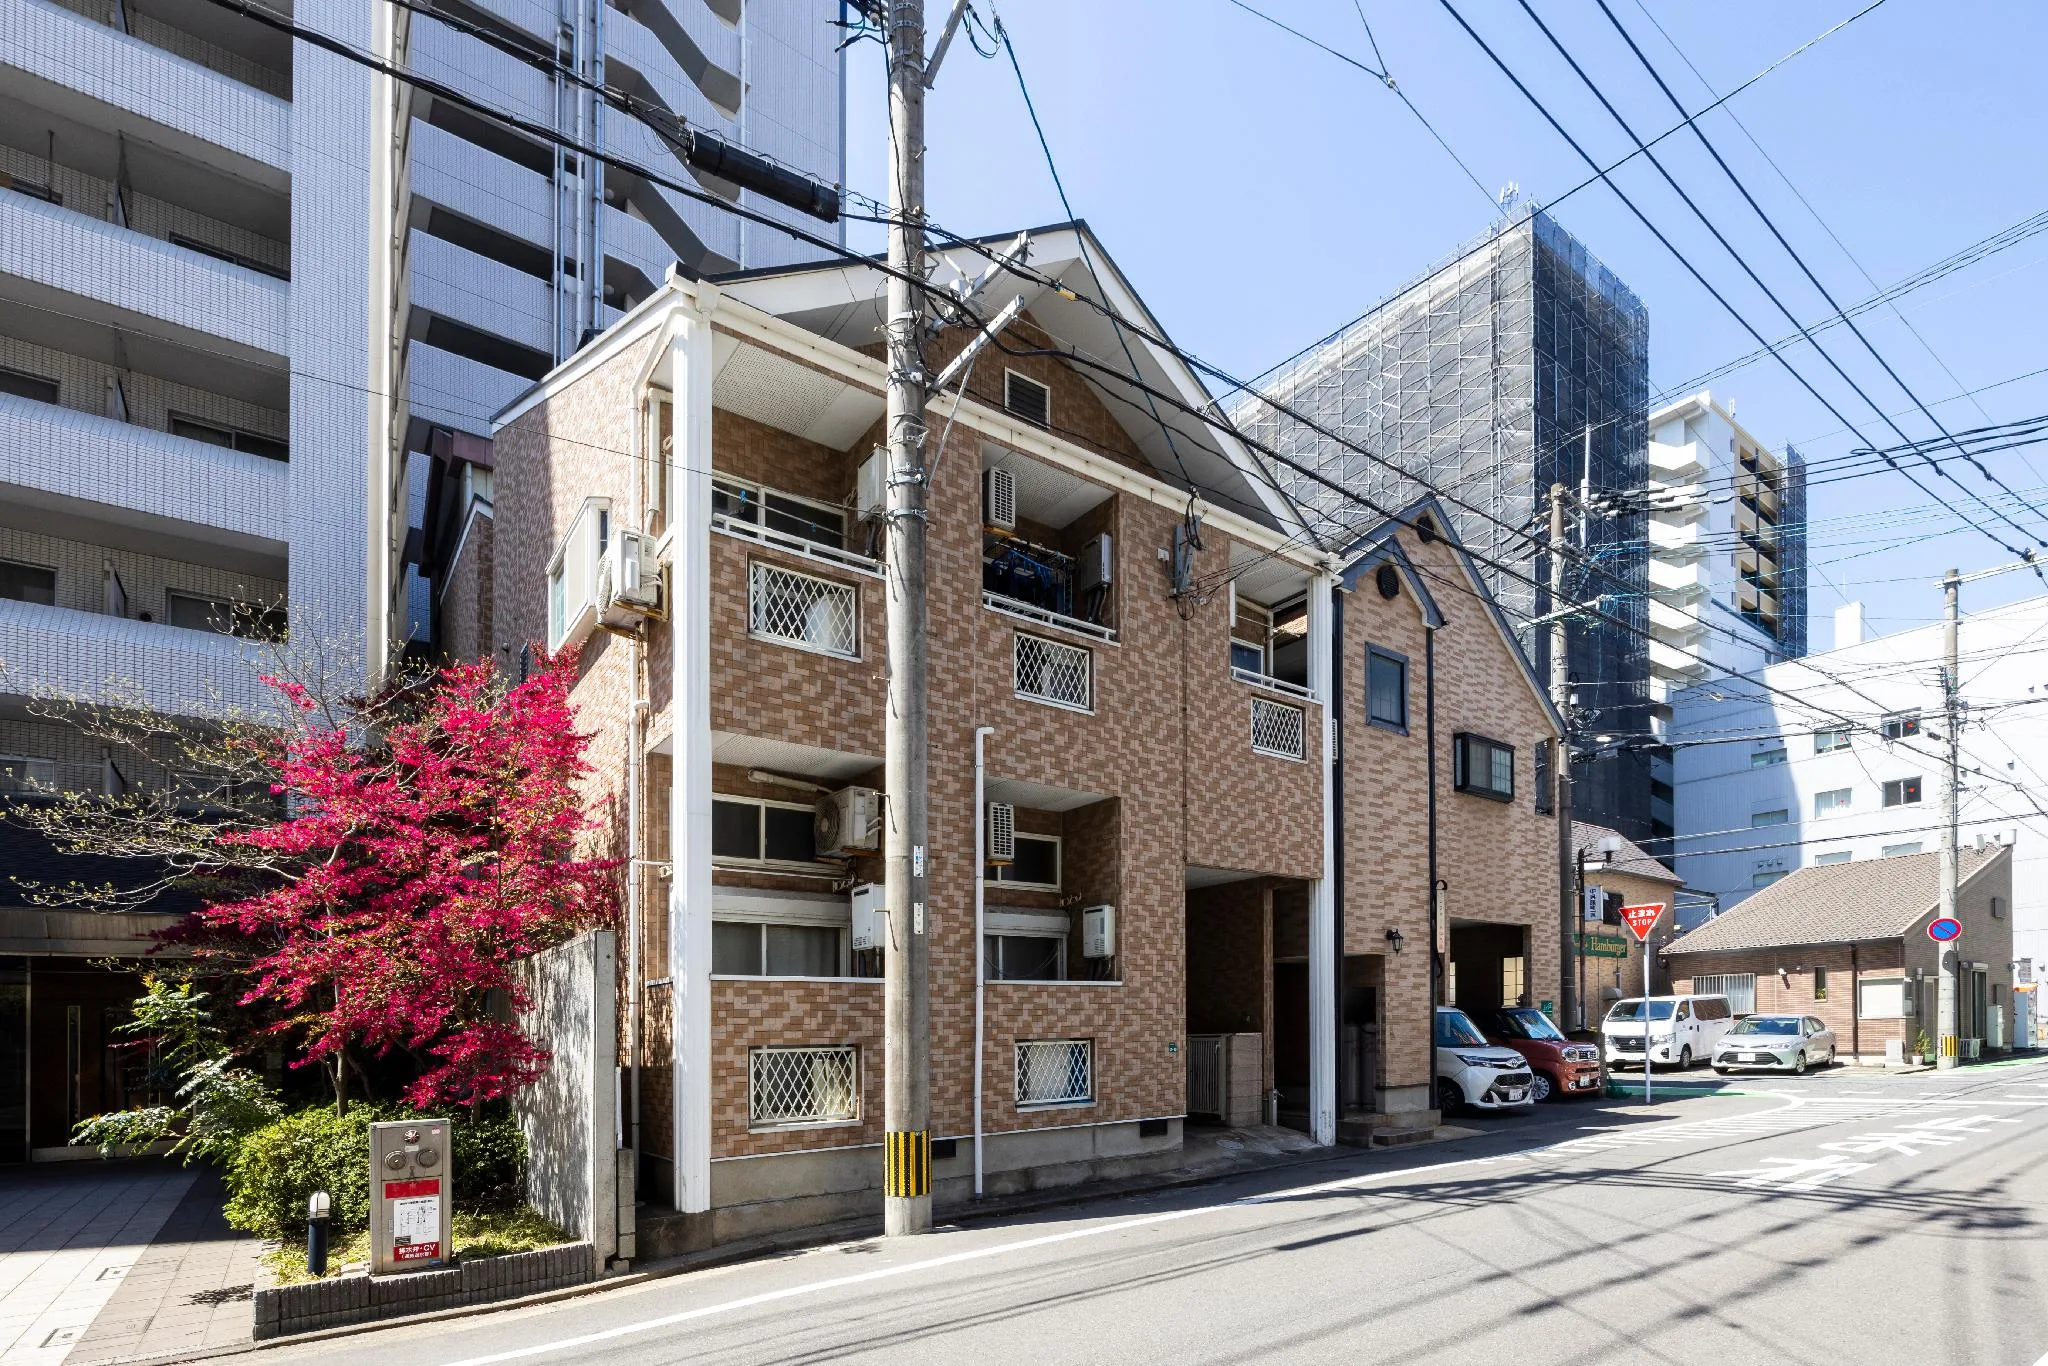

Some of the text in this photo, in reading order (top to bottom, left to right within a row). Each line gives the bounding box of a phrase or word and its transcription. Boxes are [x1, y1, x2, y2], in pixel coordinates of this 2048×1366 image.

[1628, 908, 1656, 919] 止まれ
[1632, 918, 1652, 927] STOP
[1591, 936, 1626, 957] Hamburger
[1705, 1114, 2024, 1191] 止まれ
